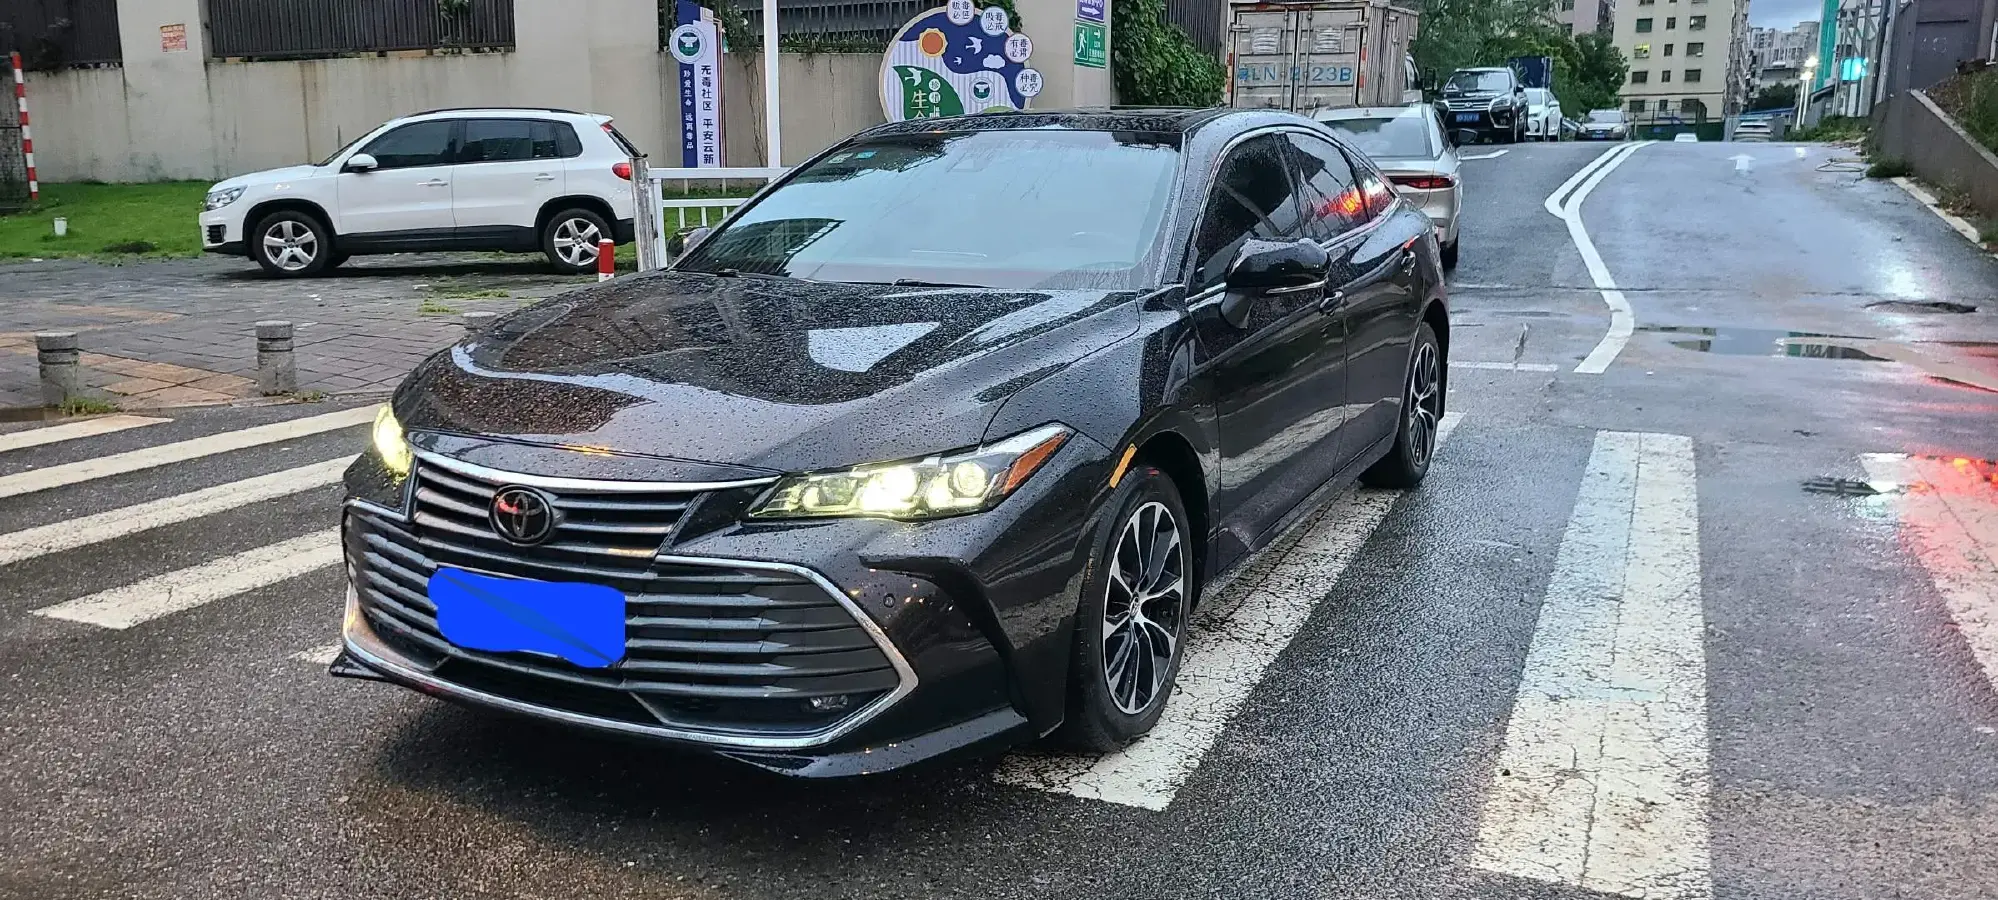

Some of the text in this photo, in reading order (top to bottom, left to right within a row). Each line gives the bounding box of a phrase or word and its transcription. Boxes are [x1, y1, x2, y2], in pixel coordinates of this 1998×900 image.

[684, 70, 692, 106] 珍爱生命
[701, 65, 714, 164] 无毒社区 平安云新
